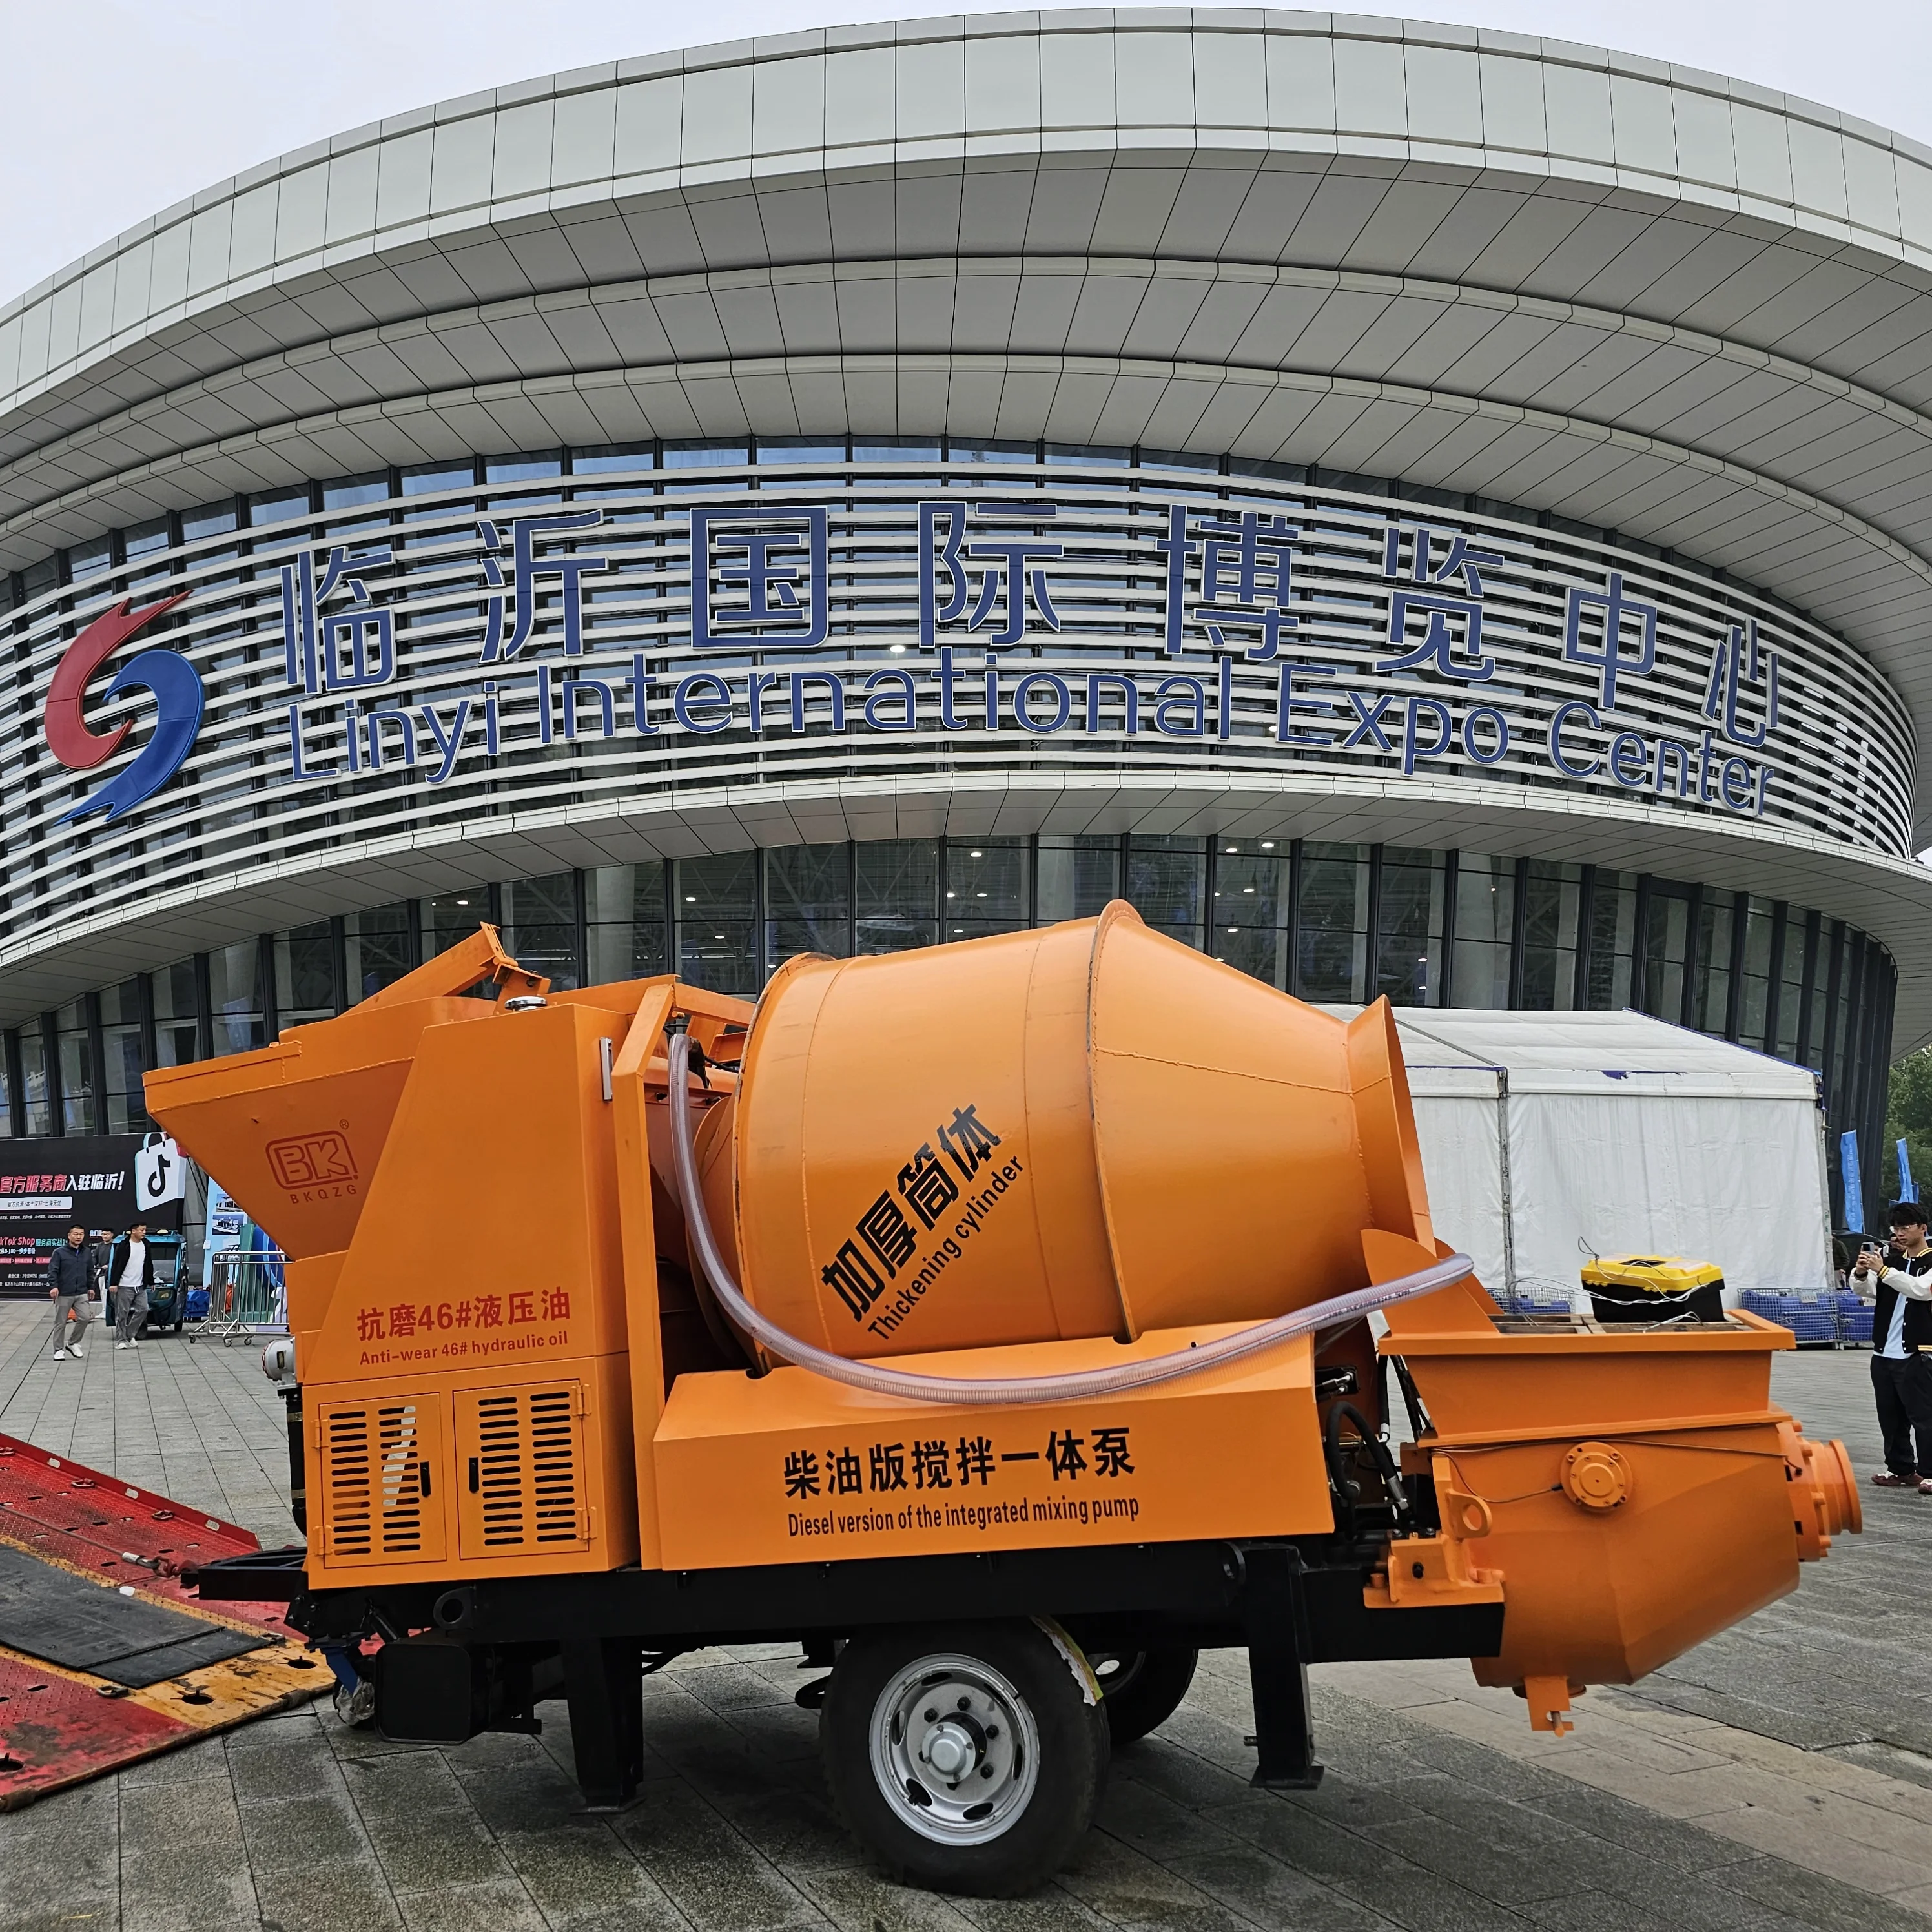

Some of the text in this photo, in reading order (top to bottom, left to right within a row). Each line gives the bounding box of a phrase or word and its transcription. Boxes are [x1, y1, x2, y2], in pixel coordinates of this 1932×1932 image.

[280, 500, 1779, 748] 临沂国际博览中心
[287, 646, 1774, 817] Linyi International Expo Center
[290, 1184, 357, 1204] BKQZG
[821, 1103, 1002, 1322] 加厚筒体
[17, 1236, 35, 1247] Shop
[867, 1155, 1024, 1341] Thickening cylinder
[356, 1286, 571, 1341] 抗磨46#液压油
[359, 1330, 568, 1366] Anti-wear 46# hydraulic oil
[783, 1426, 1136, 1500] 柴油版搅拌一体泵
[788, 1496, 1140, 1537] Diesel version of the integrated mixing pump
